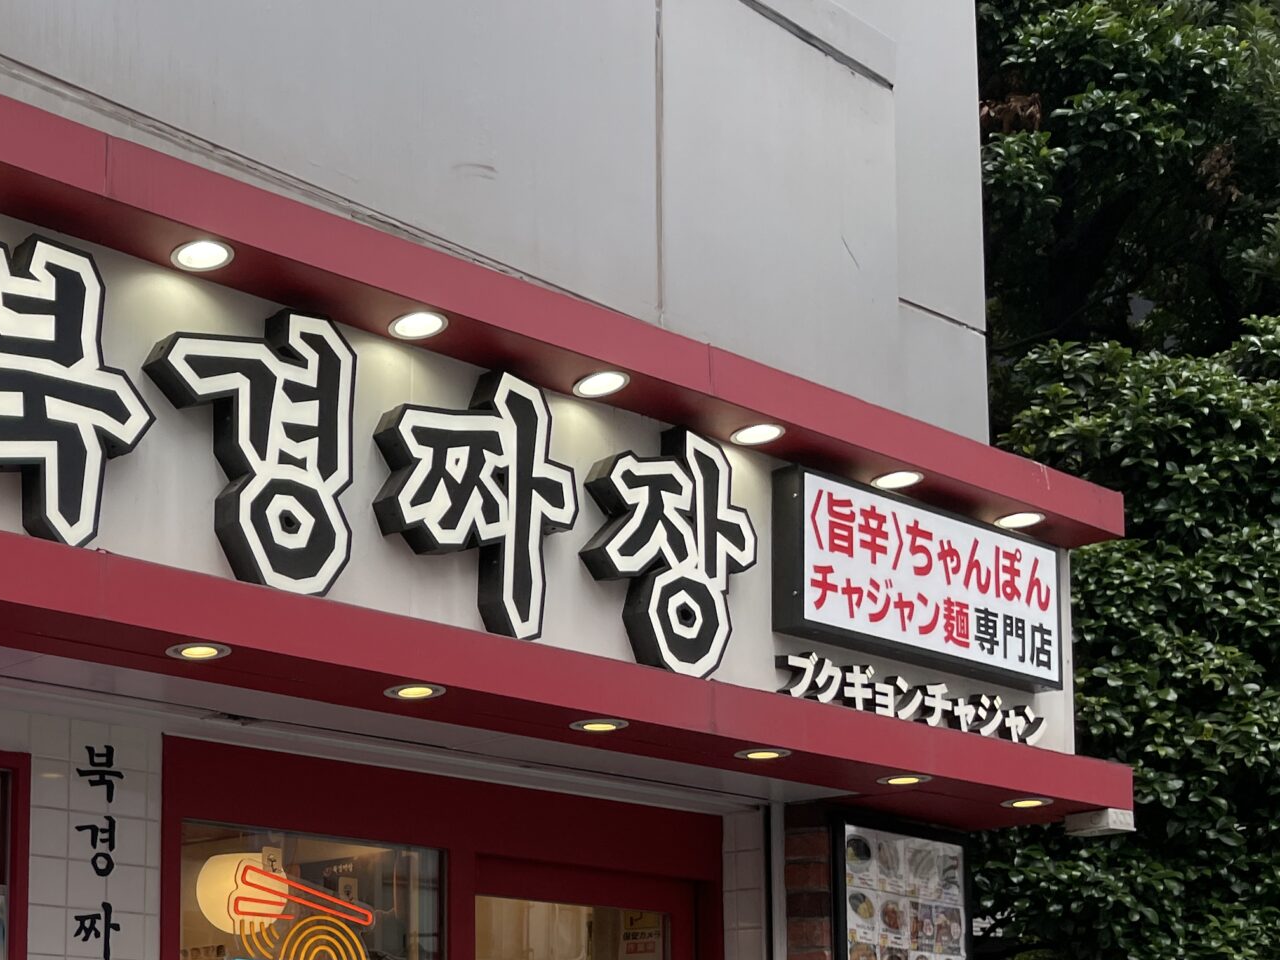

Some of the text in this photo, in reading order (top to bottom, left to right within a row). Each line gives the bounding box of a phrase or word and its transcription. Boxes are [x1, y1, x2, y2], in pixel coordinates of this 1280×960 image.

[810, 565, 1052, 671] チャジャン麺専門店
[780, 652, 1048, 746] ブクギョンチャジャン
